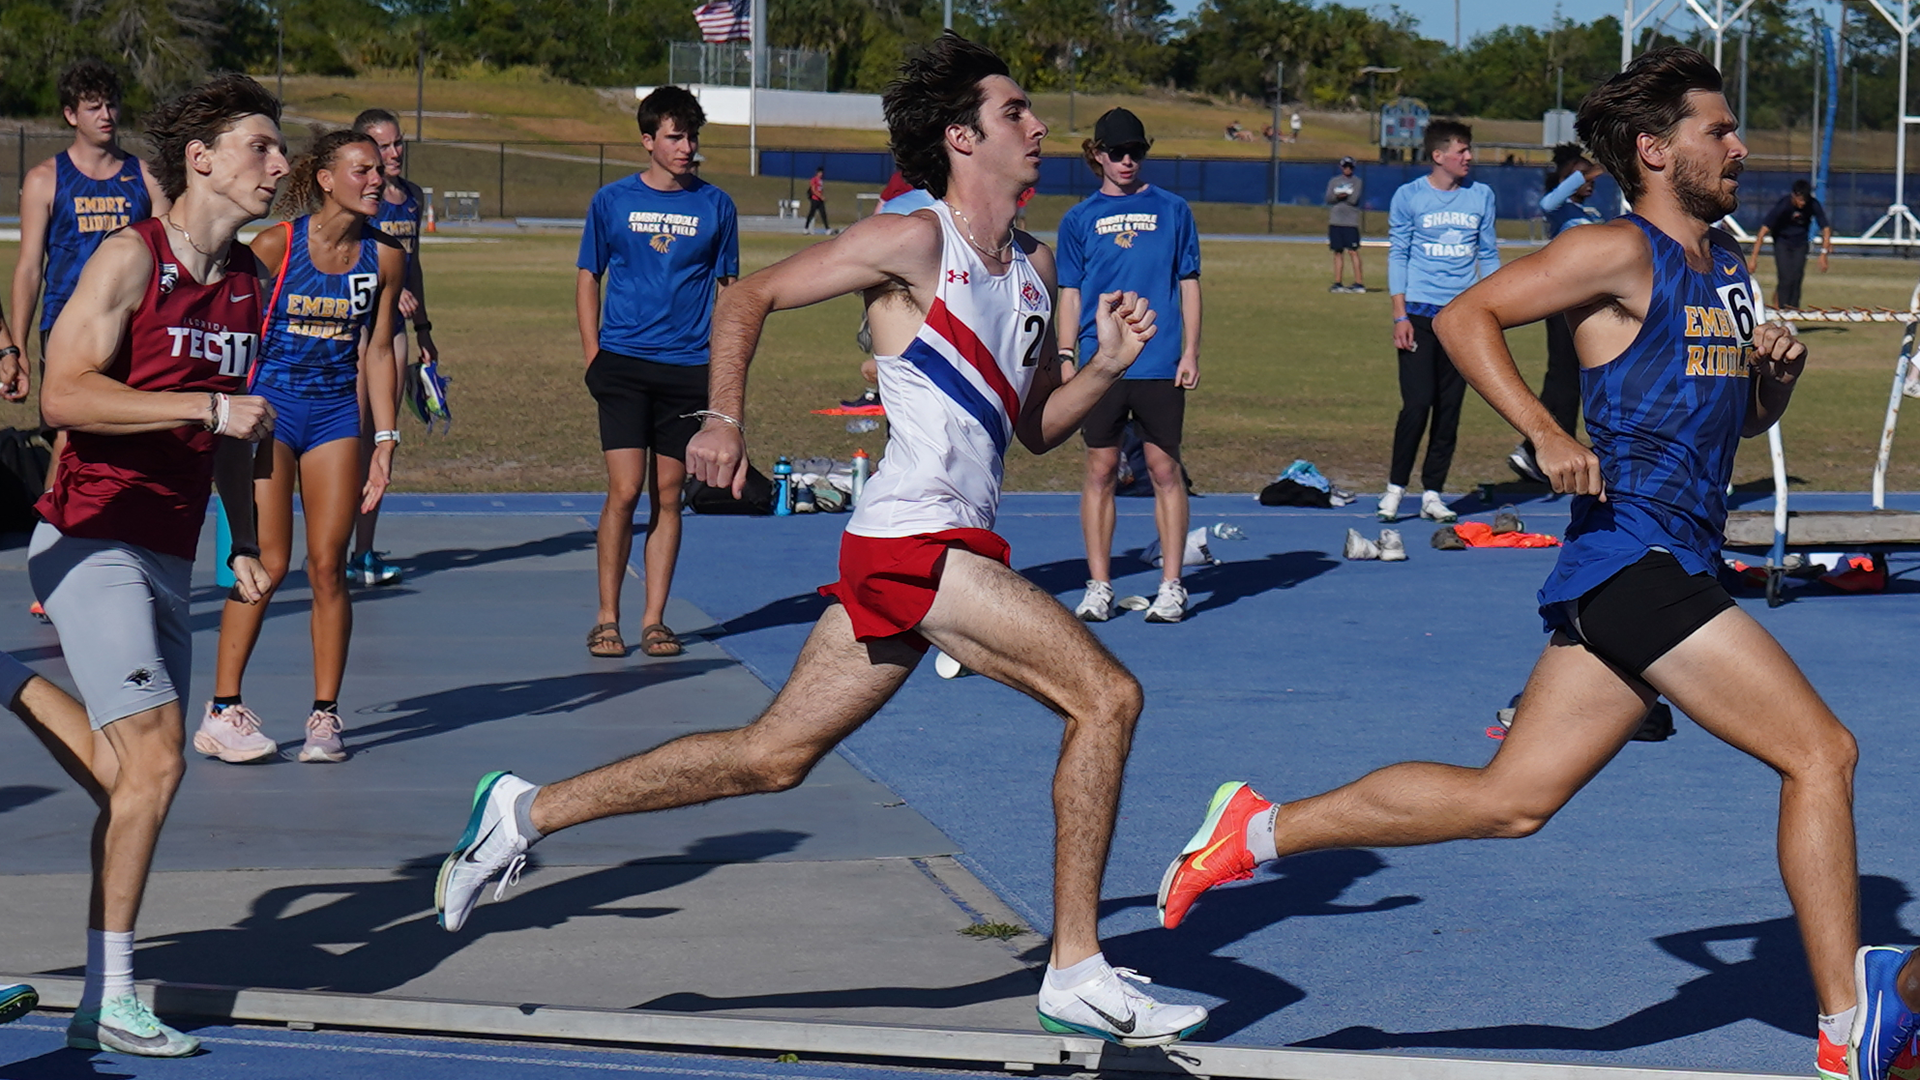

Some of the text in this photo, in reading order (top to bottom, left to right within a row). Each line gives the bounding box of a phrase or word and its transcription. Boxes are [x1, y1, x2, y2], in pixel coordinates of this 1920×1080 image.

[74, 196, 132, 213] EMBRY-
[628, 211, 699, 227] EMBRY-RIDDLE
[631, 222, 697, 237] TRACK & FIELD
[1133, 222, 1157, 231] FIELD
[1422, 211, 1479, 230] SHARKS
[353, 276, 371, 311] 5
[286, 294, 357, 319] EMBR
[1728, 287, 1754, 342] 6
[166, 327, 252, 374] TEC 11
[1022, 315, 1045, 367] 2
